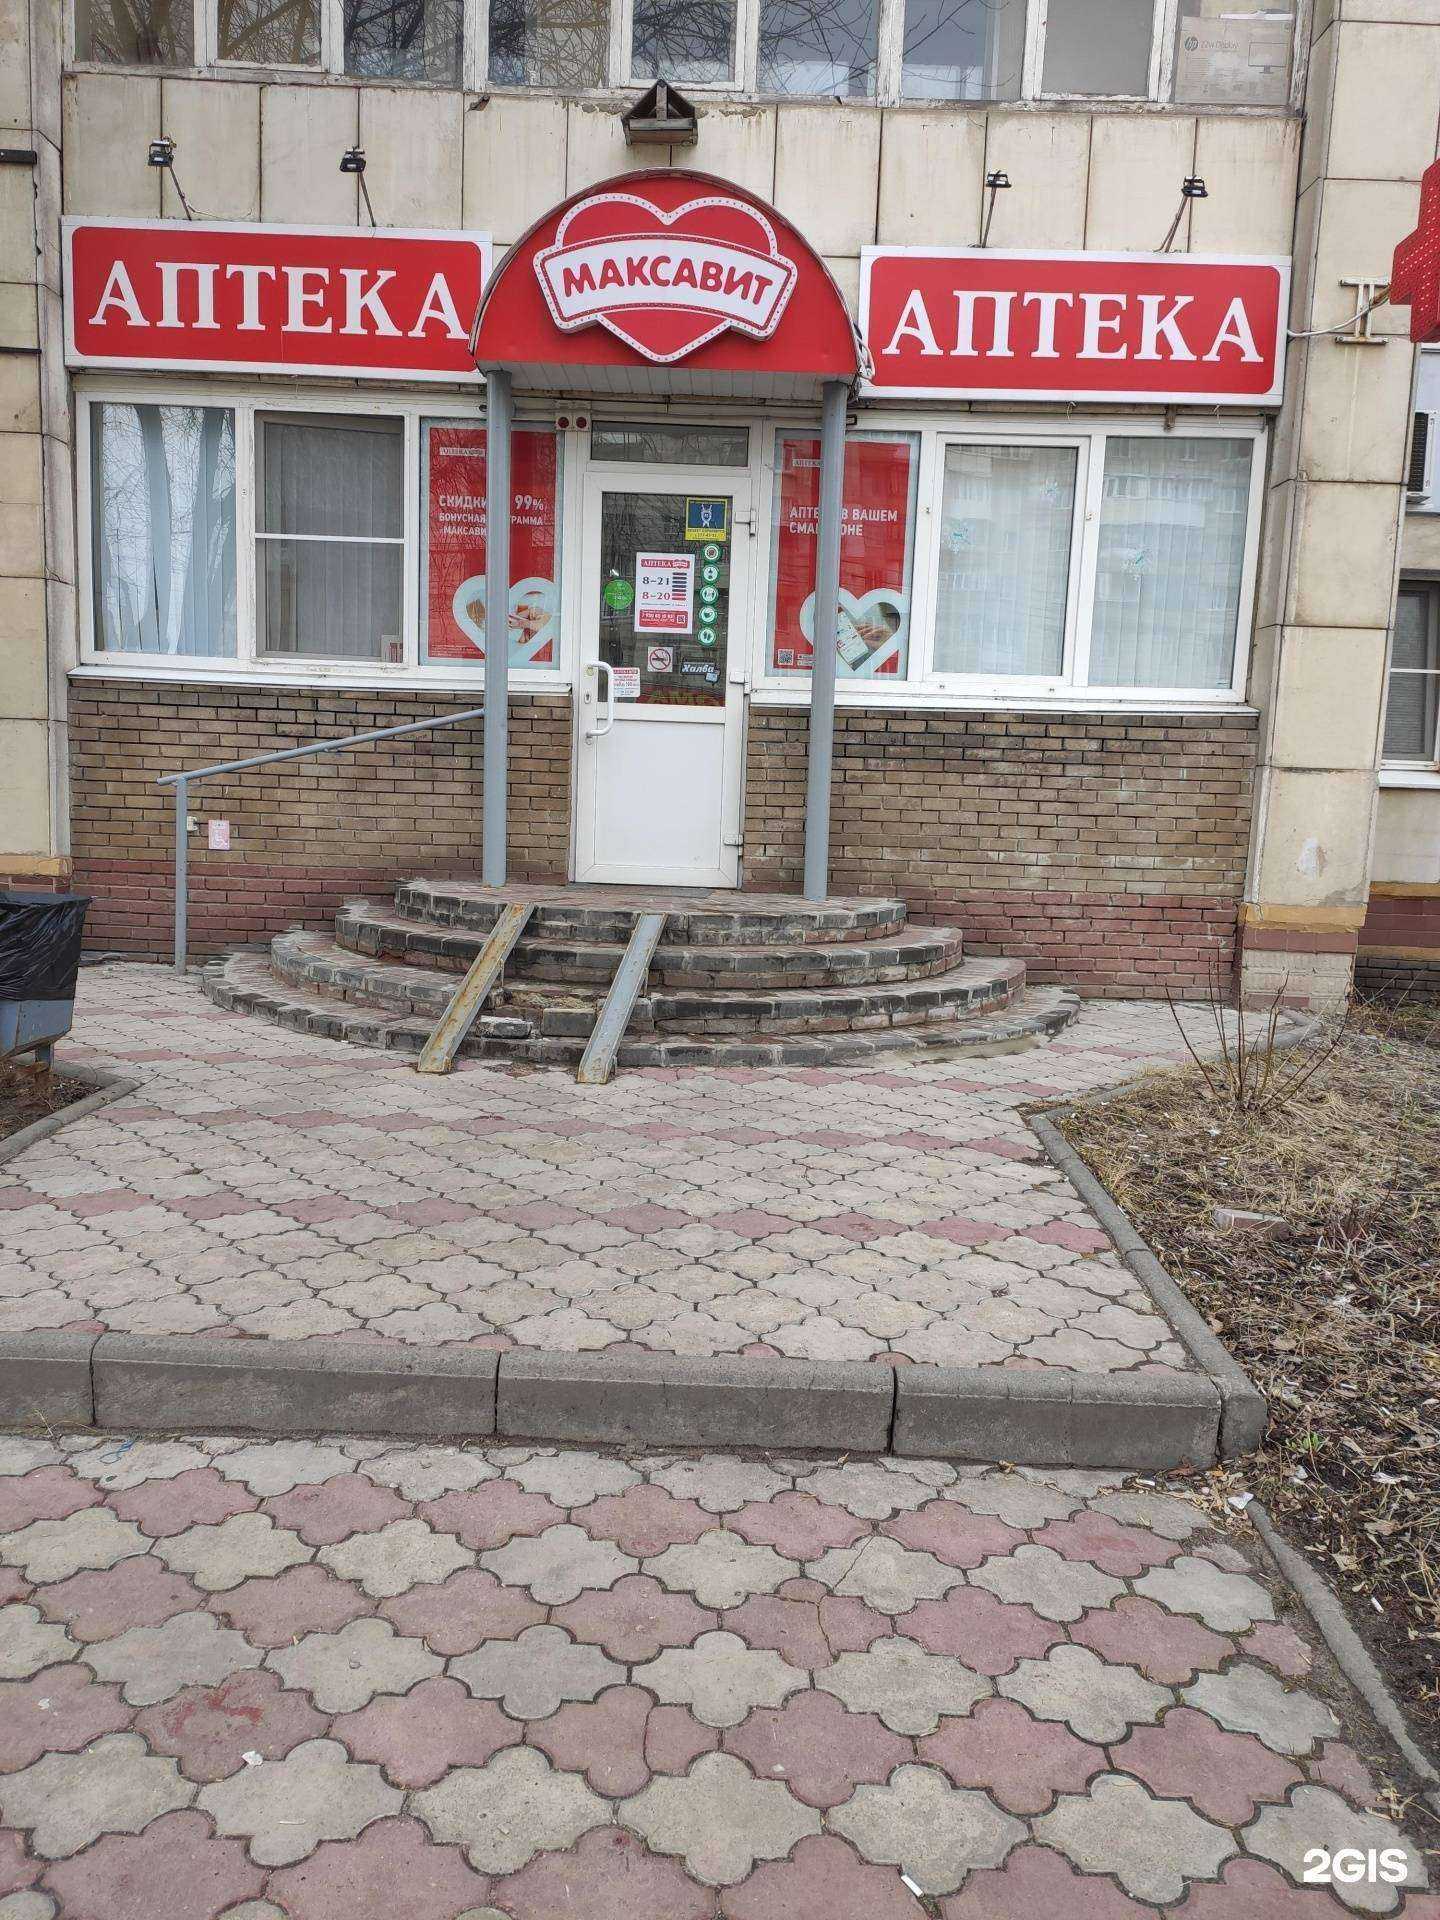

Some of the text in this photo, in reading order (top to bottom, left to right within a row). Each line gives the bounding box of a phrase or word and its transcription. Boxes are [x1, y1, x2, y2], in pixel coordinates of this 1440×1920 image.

[562, 255, 773, 305] МАКСАВИТ
[88, 259, 470, 340] АПТЕКА
[881, 288, 1264, 363] АПТЕКА
[439, 512, 487, 523] БОНУСНАЯ
[790, 507, 820, 519] АПТЕ
[852, 509, 898, 522] ВАШЕМ
[790, 522, 864, 536] СМАОНЕ
[682, 664, 714, 672] Халва
